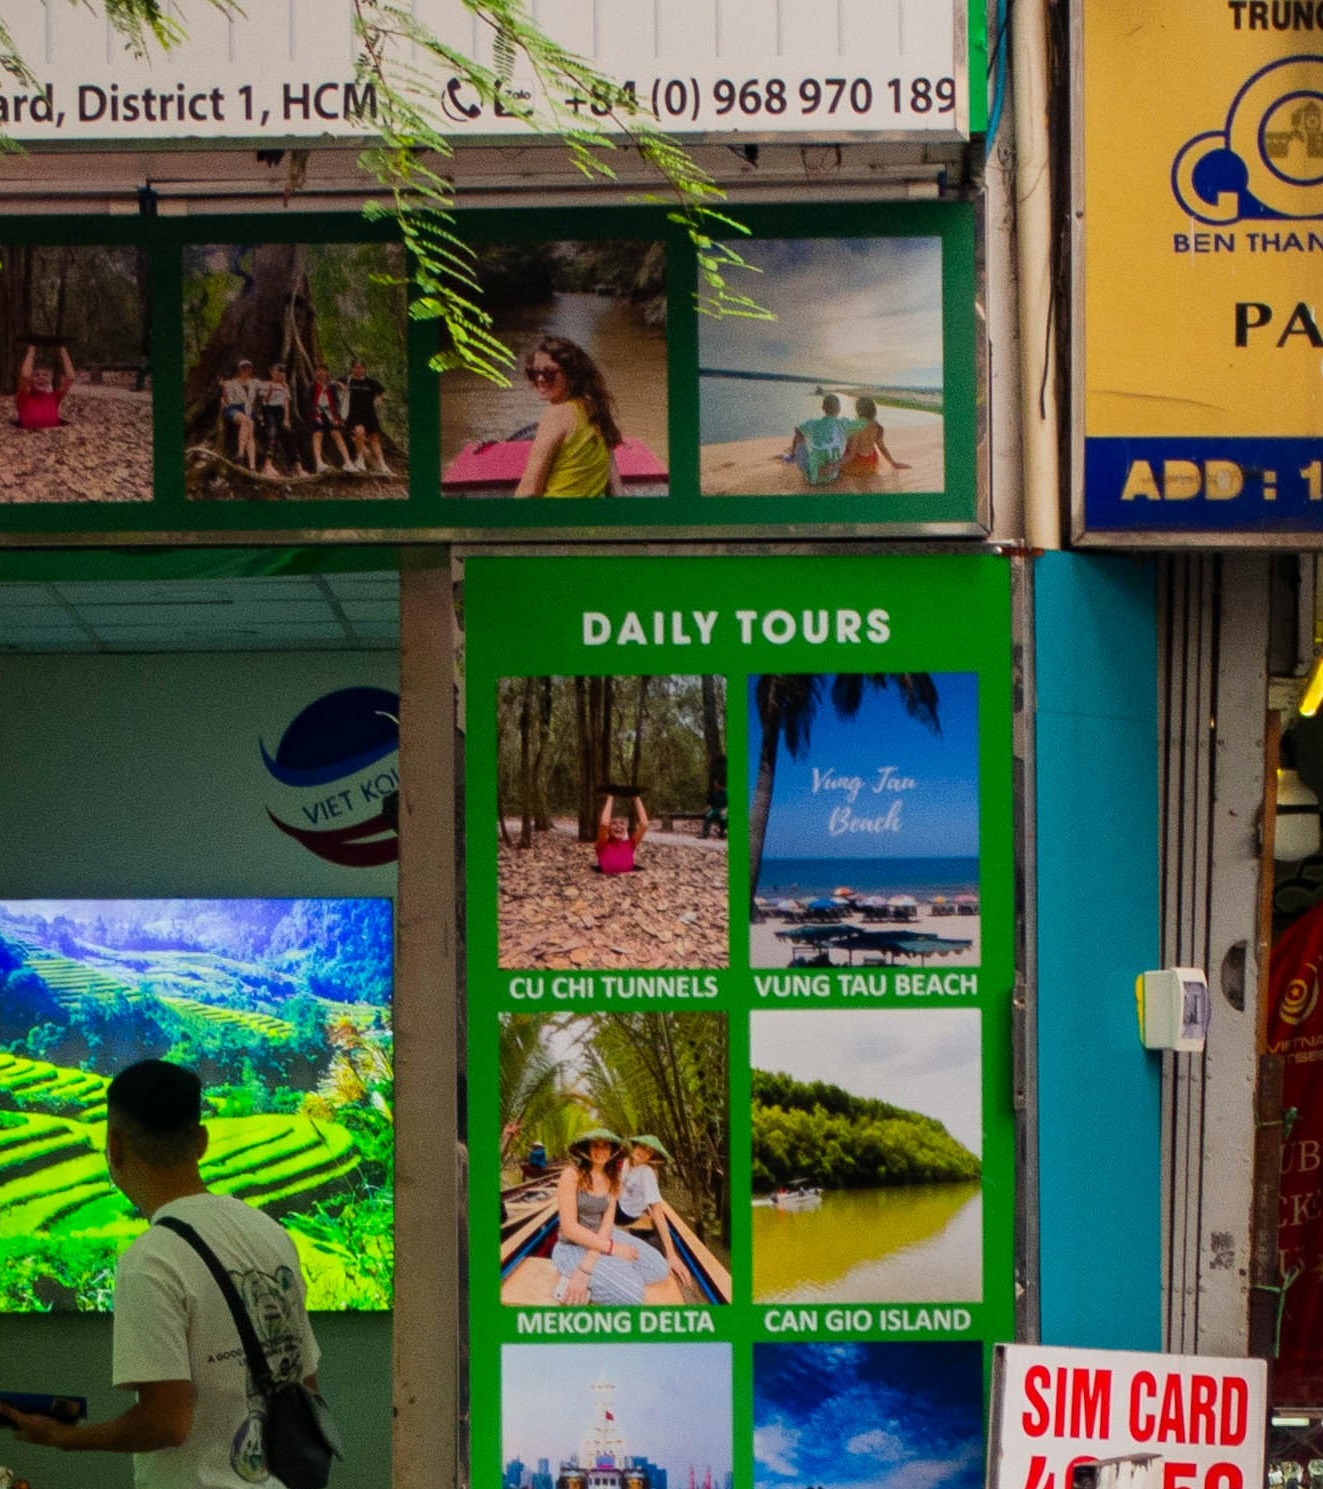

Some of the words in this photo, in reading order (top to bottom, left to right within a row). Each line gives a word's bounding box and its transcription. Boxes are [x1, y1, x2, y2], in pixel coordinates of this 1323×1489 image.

[79, 80, 223, 122] District
[652, 78, 699, 121] (0)
[714, 79, 786, 115] 968
[799, 78, 872, 114] 970
[888, 78, 955, 113] 189
[1174, 234, 1234, 252] BEN
[583, 611, 718, 645] DAILY
[736, 609, 890, 644] TOURS
[302, 790, 353, 825] VIET
[828, 799, 903, 836] Beach
[510, 978, 543, 999] CU
[552, 978, 593, 998] CHI
[602, 977, 717, 998] TUNNELS
[754, 976, 830, 997] VUNG
[838, 975, 886, 995] TAU
[895, 973, 977, 996] BEACH
[517, 1313, 631, 1333] MEKONG
[639, 1311, 714, 1332] DELTA
[765, 1311, 817, 1331] CAN
[826, 1310, 872, 1331] GIO
[881, 1310, 970, 1330] ISLAND
[1022, 1365, 1112, 1439] SIM
[1129, 1371, 1248, 1446] CARD
